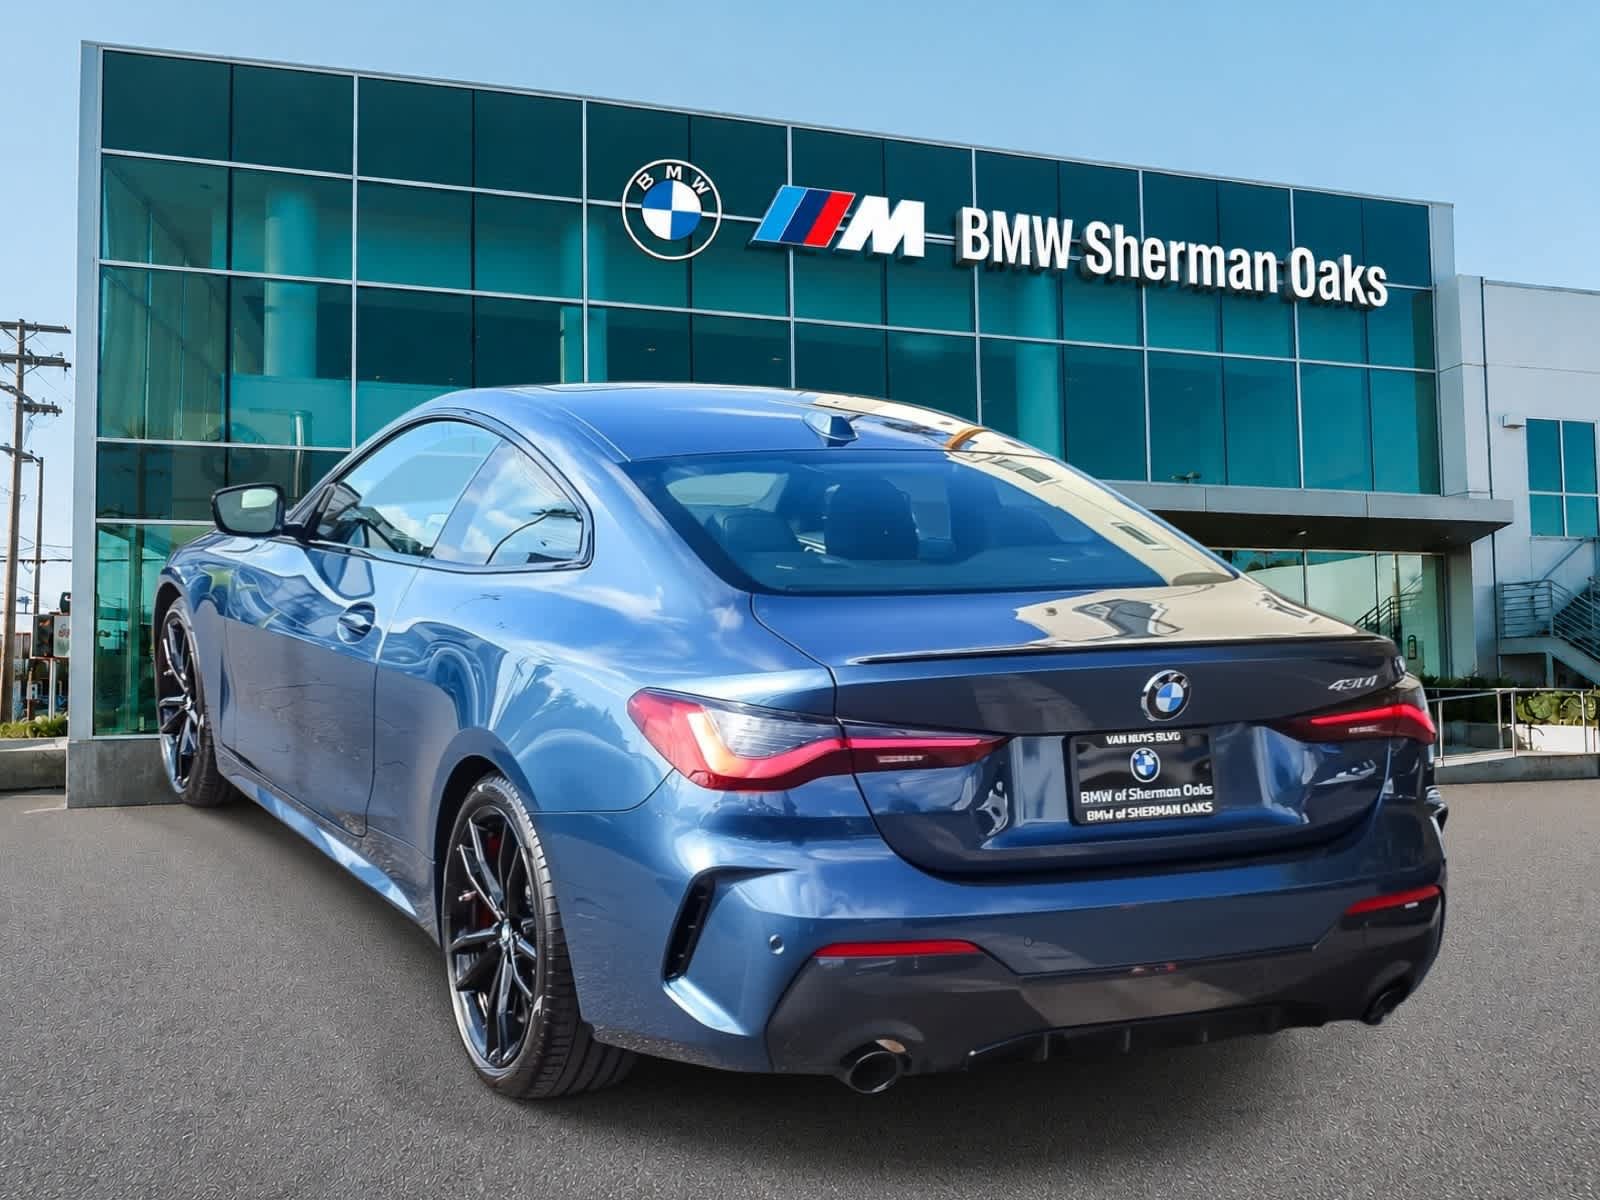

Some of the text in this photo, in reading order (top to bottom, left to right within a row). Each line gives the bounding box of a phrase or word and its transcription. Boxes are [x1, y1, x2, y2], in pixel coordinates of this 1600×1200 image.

[636, 165, 711, 195] BMW
[835, 195, 925, 257] M
[959, 206, 1389, 308] BMW Sherman Oaks
[1106, 731, 1181, 745] VAN NUYS BLVD
[1080, 783, 1213, 804] BMW of Sherman Oaks
[1086, 802, 1213, 821] BMW of SHERMAN OAKS
